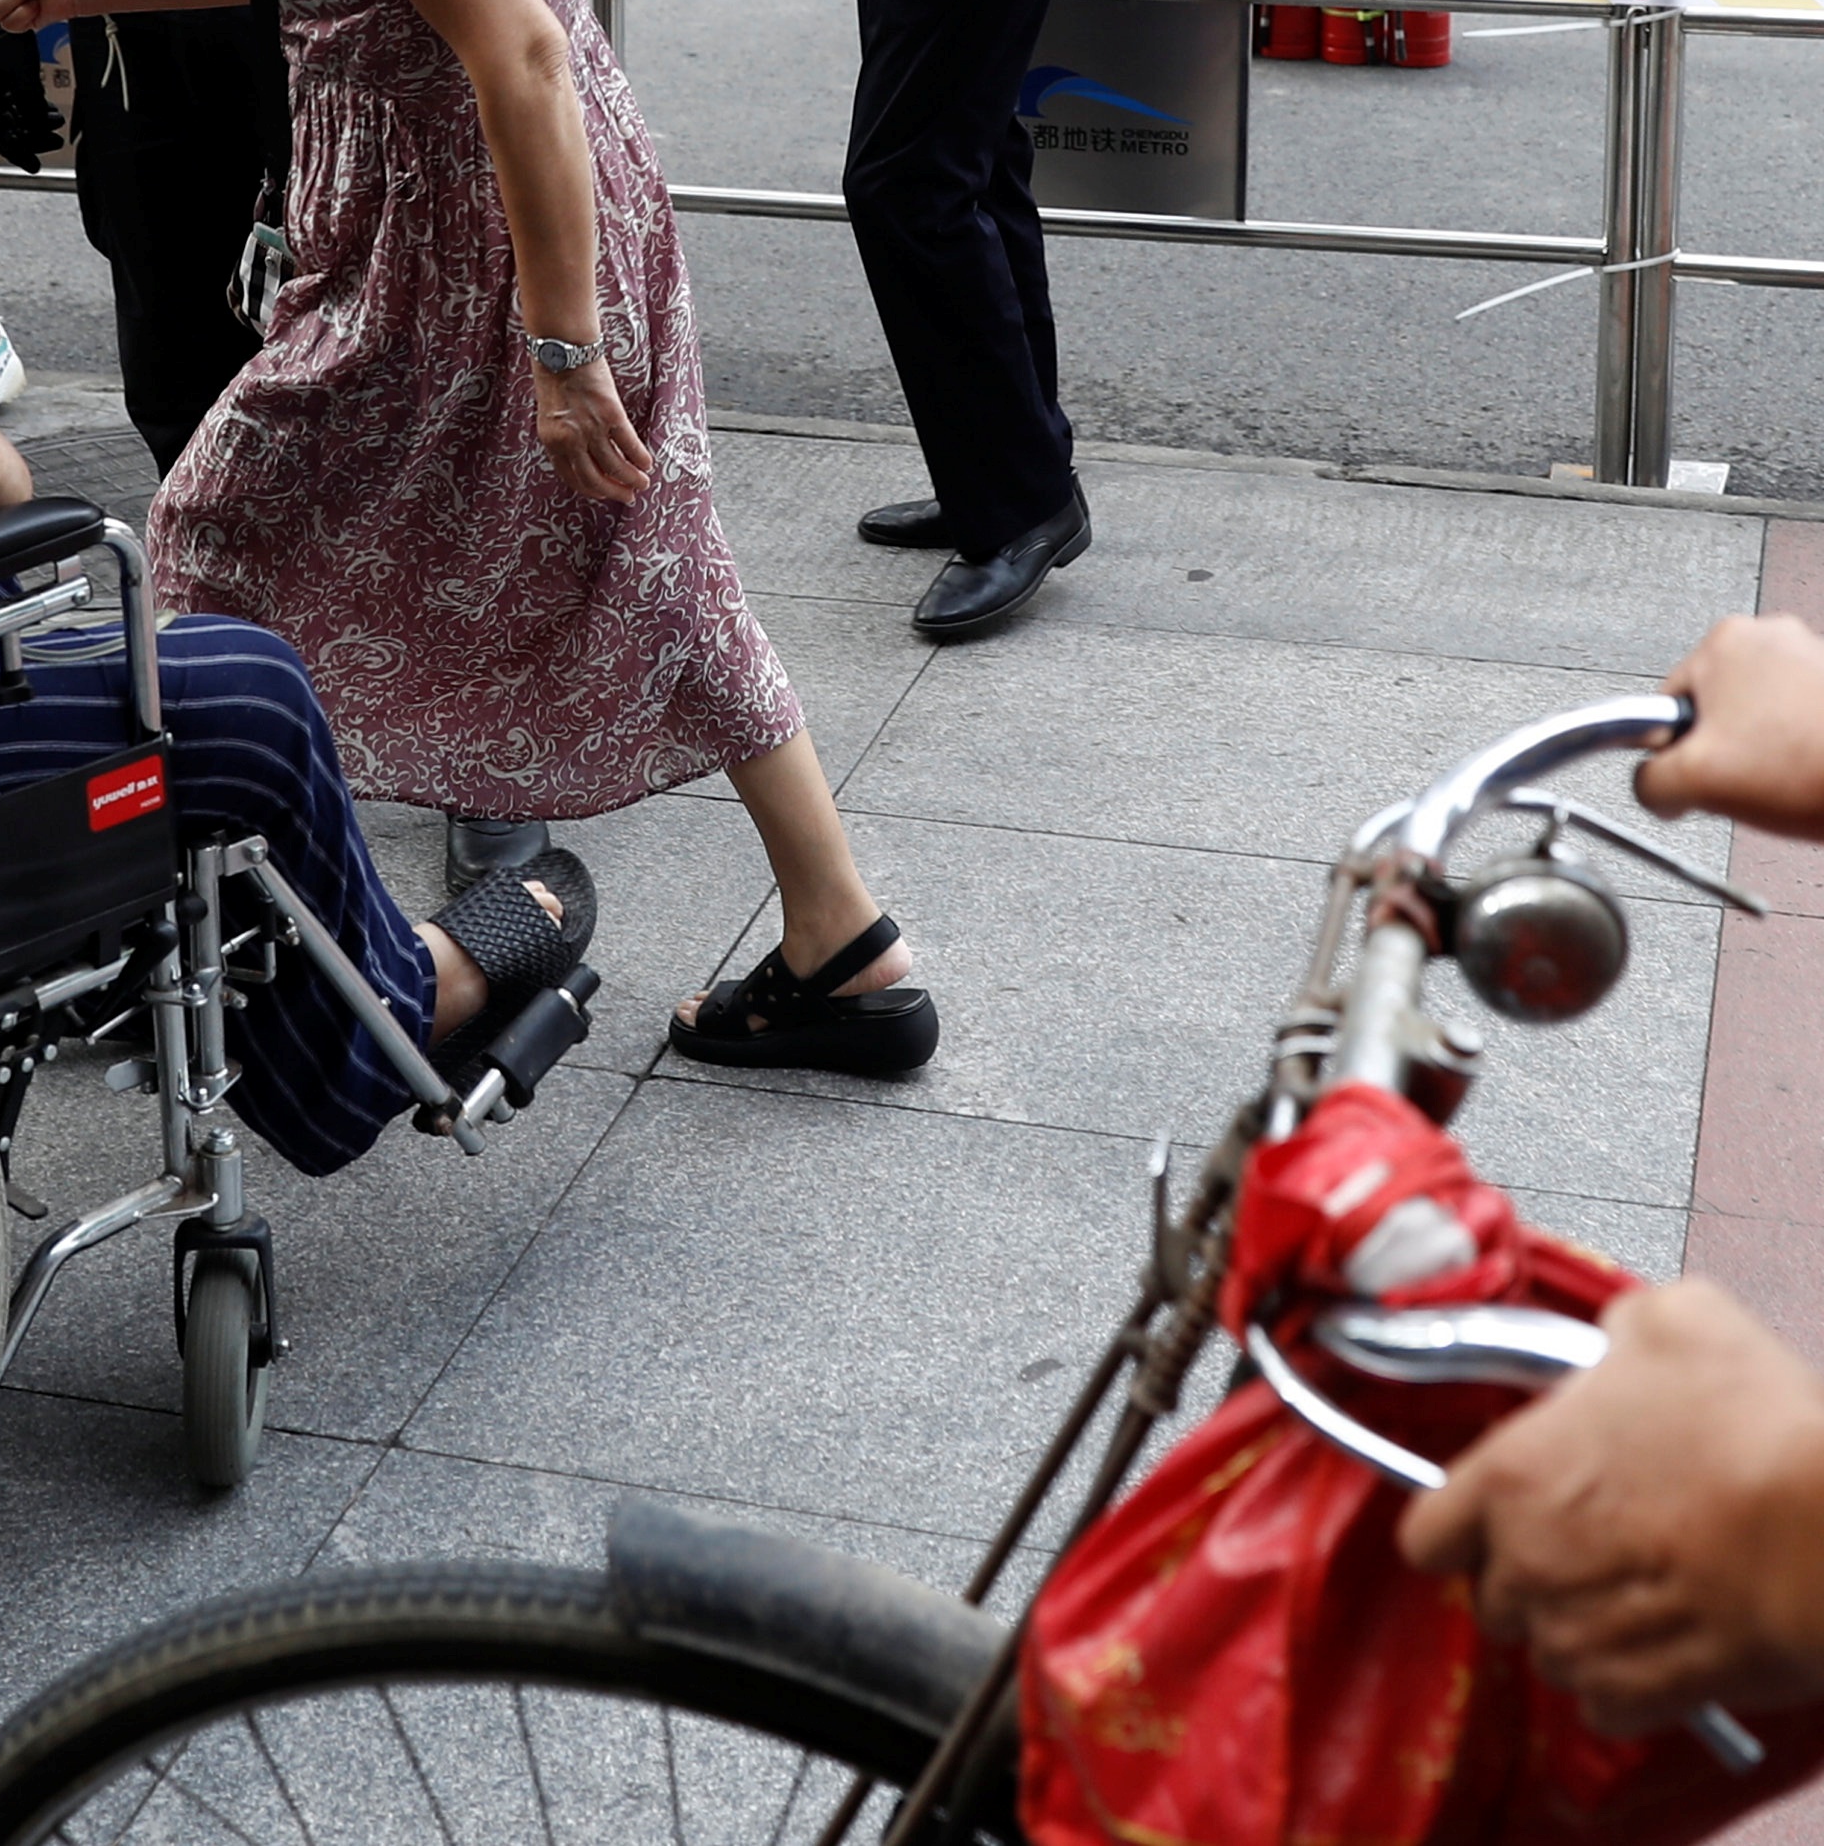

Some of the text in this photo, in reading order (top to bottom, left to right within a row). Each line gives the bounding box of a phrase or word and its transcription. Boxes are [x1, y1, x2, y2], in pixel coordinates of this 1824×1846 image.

[1026, 123, 1117, 154] 都地铁
[1120, 141, 1189, 156] METRO
